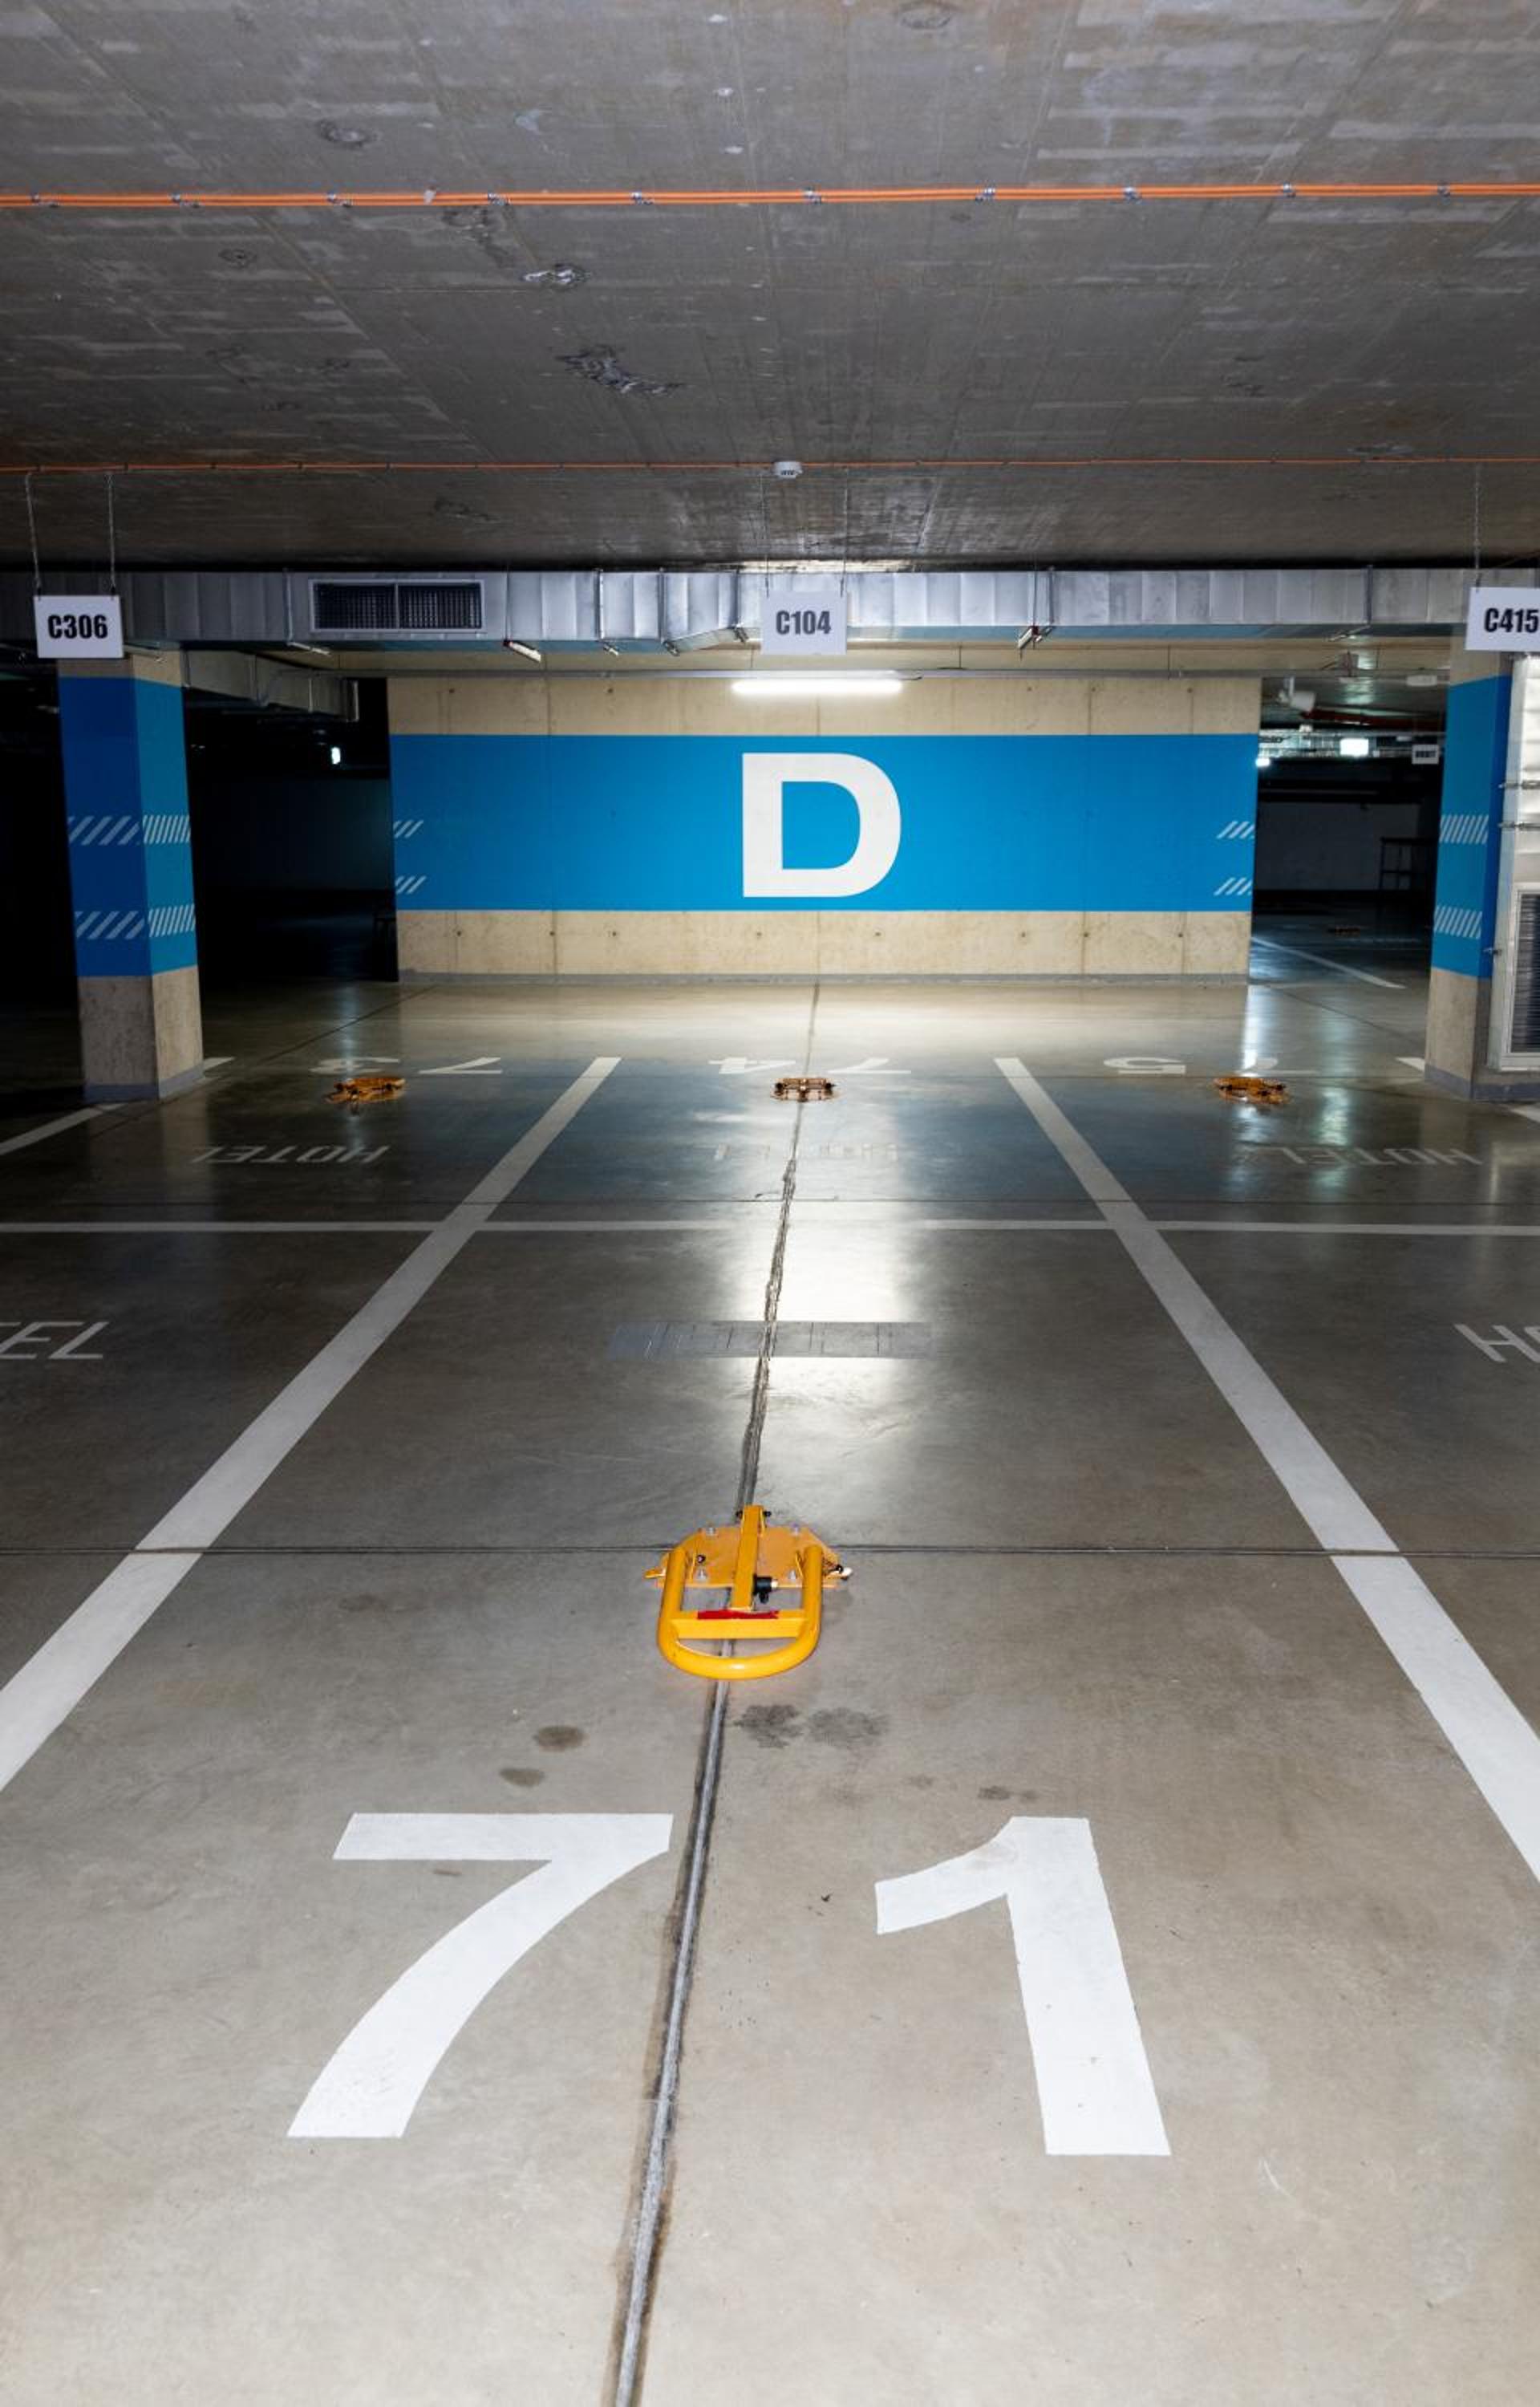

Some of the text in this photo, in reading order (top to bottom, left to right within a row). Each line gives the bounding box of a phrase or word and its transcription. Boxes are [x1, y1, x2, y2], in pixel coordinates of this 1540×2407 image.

[48, 615, 107, 639] C306
[776, 610, 831, 635] C104
[1485, 608, 1539, 633] C415
[742, 753, 902, 898] D
[190, 1145, 391, 1163] HOTEL
[287, 1812, 1171, 2155] 71
